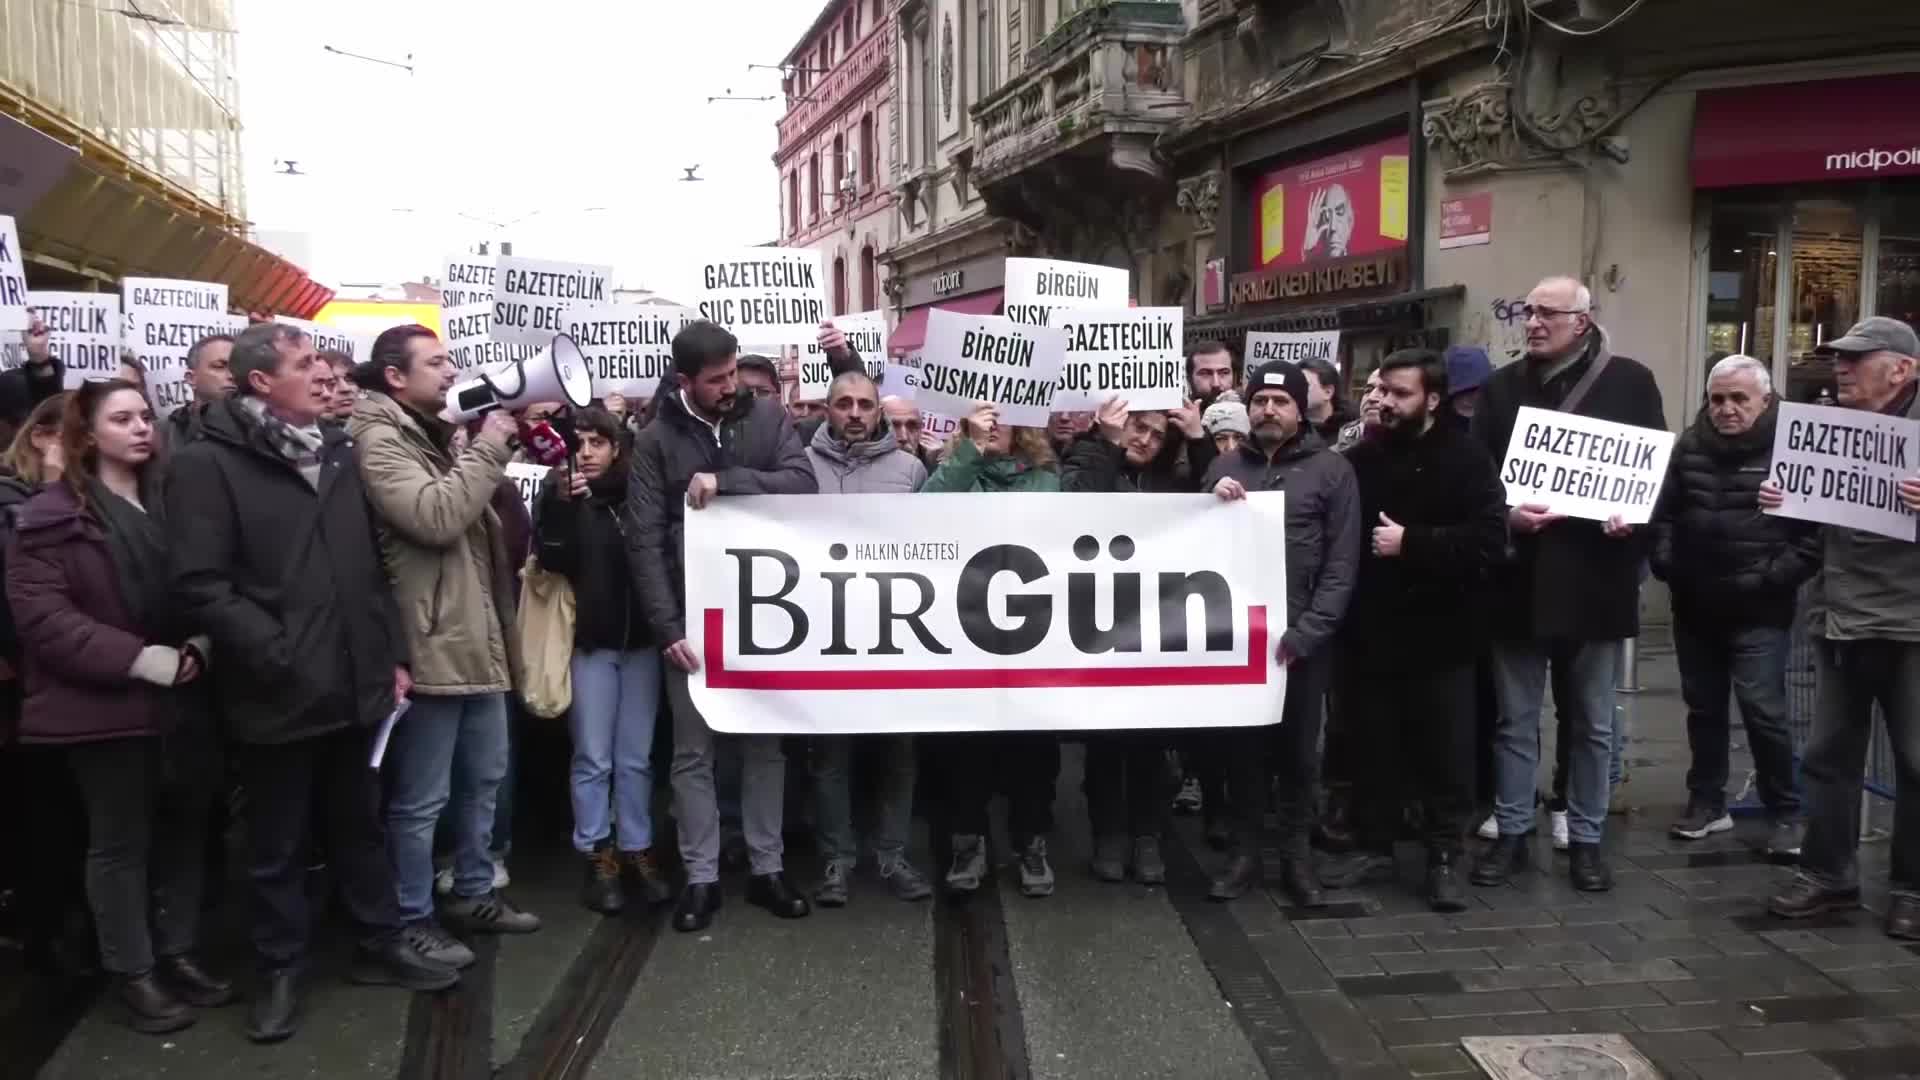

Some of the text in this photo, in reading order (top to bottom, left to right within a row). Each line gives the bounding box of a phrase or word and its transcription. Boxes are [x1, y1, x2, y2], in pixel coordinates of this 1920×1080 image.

[1825, 147, 1920, 170] midpoi
[448, 263, 496, 286] GAZETE
[505, 268, 605, 301] GAZETECİLİK
[704, 255, 815, 290] GAZETECİLİK
[1036, 266, 1099, 300] BİRGÜN
[133, 286, 220, 311] GAZETECİLİK
[699, 299, 735, 331] SUÇ
[740, 292, 824, 325] DEĞİLDİR!
[28, 300, 108, 335] TECİLİK
[494, 302, 529, 333] SUÇ
[570, 314, 672, 346] GAZETECİLİK
[1063, 315, 1174, 352] GAZETECİLİK
[48, 336, 117, 372] ĞİLDİR!
[312, 328, 355, 353] İRGÜN
[960, 325, 1036, 368] BİRGÜN
[1253, 337, 1332, 361] GAZETECİLİK
[599, 349, 673, 380] DEĞİLDİ
[802, 362, 830, 389] SUÇ
[1057, 355, 1181, 397] SUÇ DEĞİLDİR!
[920, 363, 1057, 408] SUSMAYACAK!
[1524, 423, 1657, 471] GAZETECİLİK
[1788, 419, 1908, 469] GAZETECİLİK
[1505, 458, 1657, 506] SUÇ DEĞİLDİR!
[1772, 461, 1914, 517] SUÇ DEĞİLDİ
[855, 540, 960, 562] HALKIN GAZETESİ
